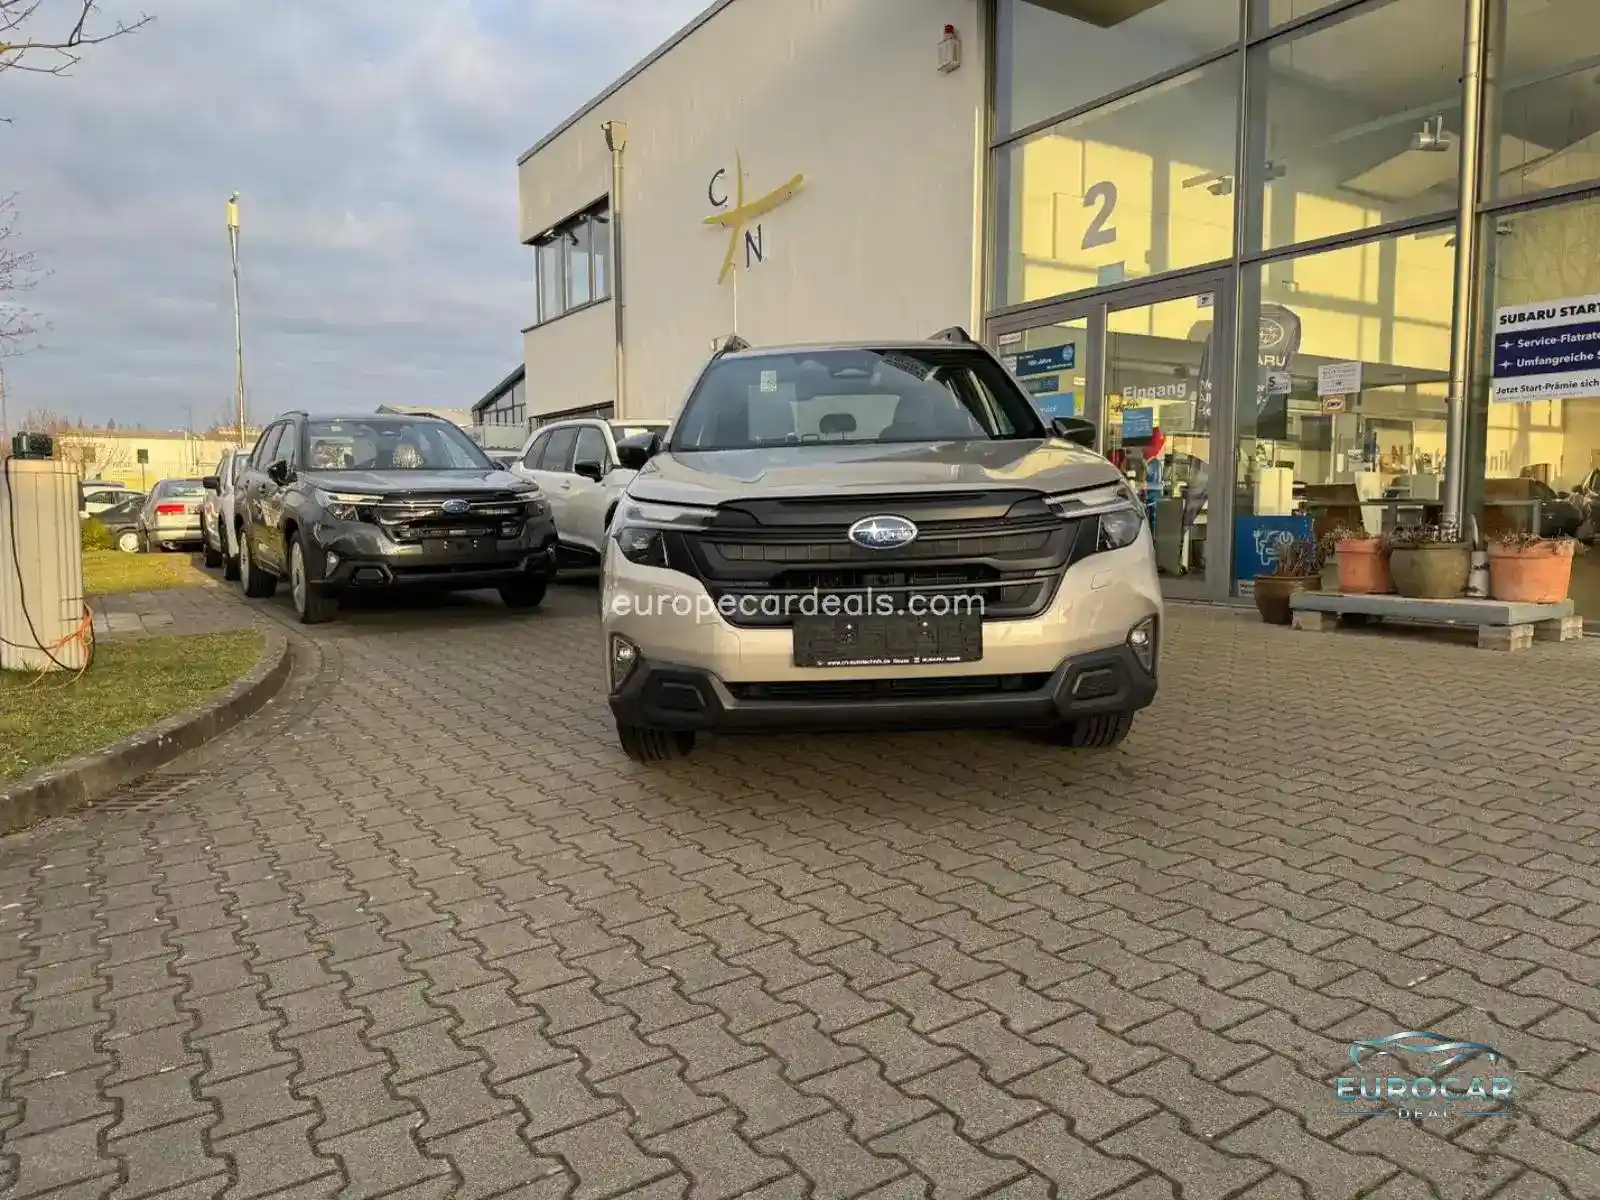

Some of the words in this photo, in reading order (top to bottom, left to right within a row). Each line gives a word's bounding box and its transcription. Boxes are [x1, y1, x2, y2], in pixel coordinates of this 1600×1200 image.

[708, 168, 728, 207] C
[1081, 180, 1117, 250] 2
[744, 223, 762, 268] N
[1500, 308, 1556, 325] SUBARU
[1516, 351, 1594, 368] Umfangreiche
[1123, 383, 1187, 401] Eingang
[1496, 386, 1518, 395] Jetzt
[1520, 381, 1578, 392] Start-Prämie
[1580, 379, 1600, 387] sich
